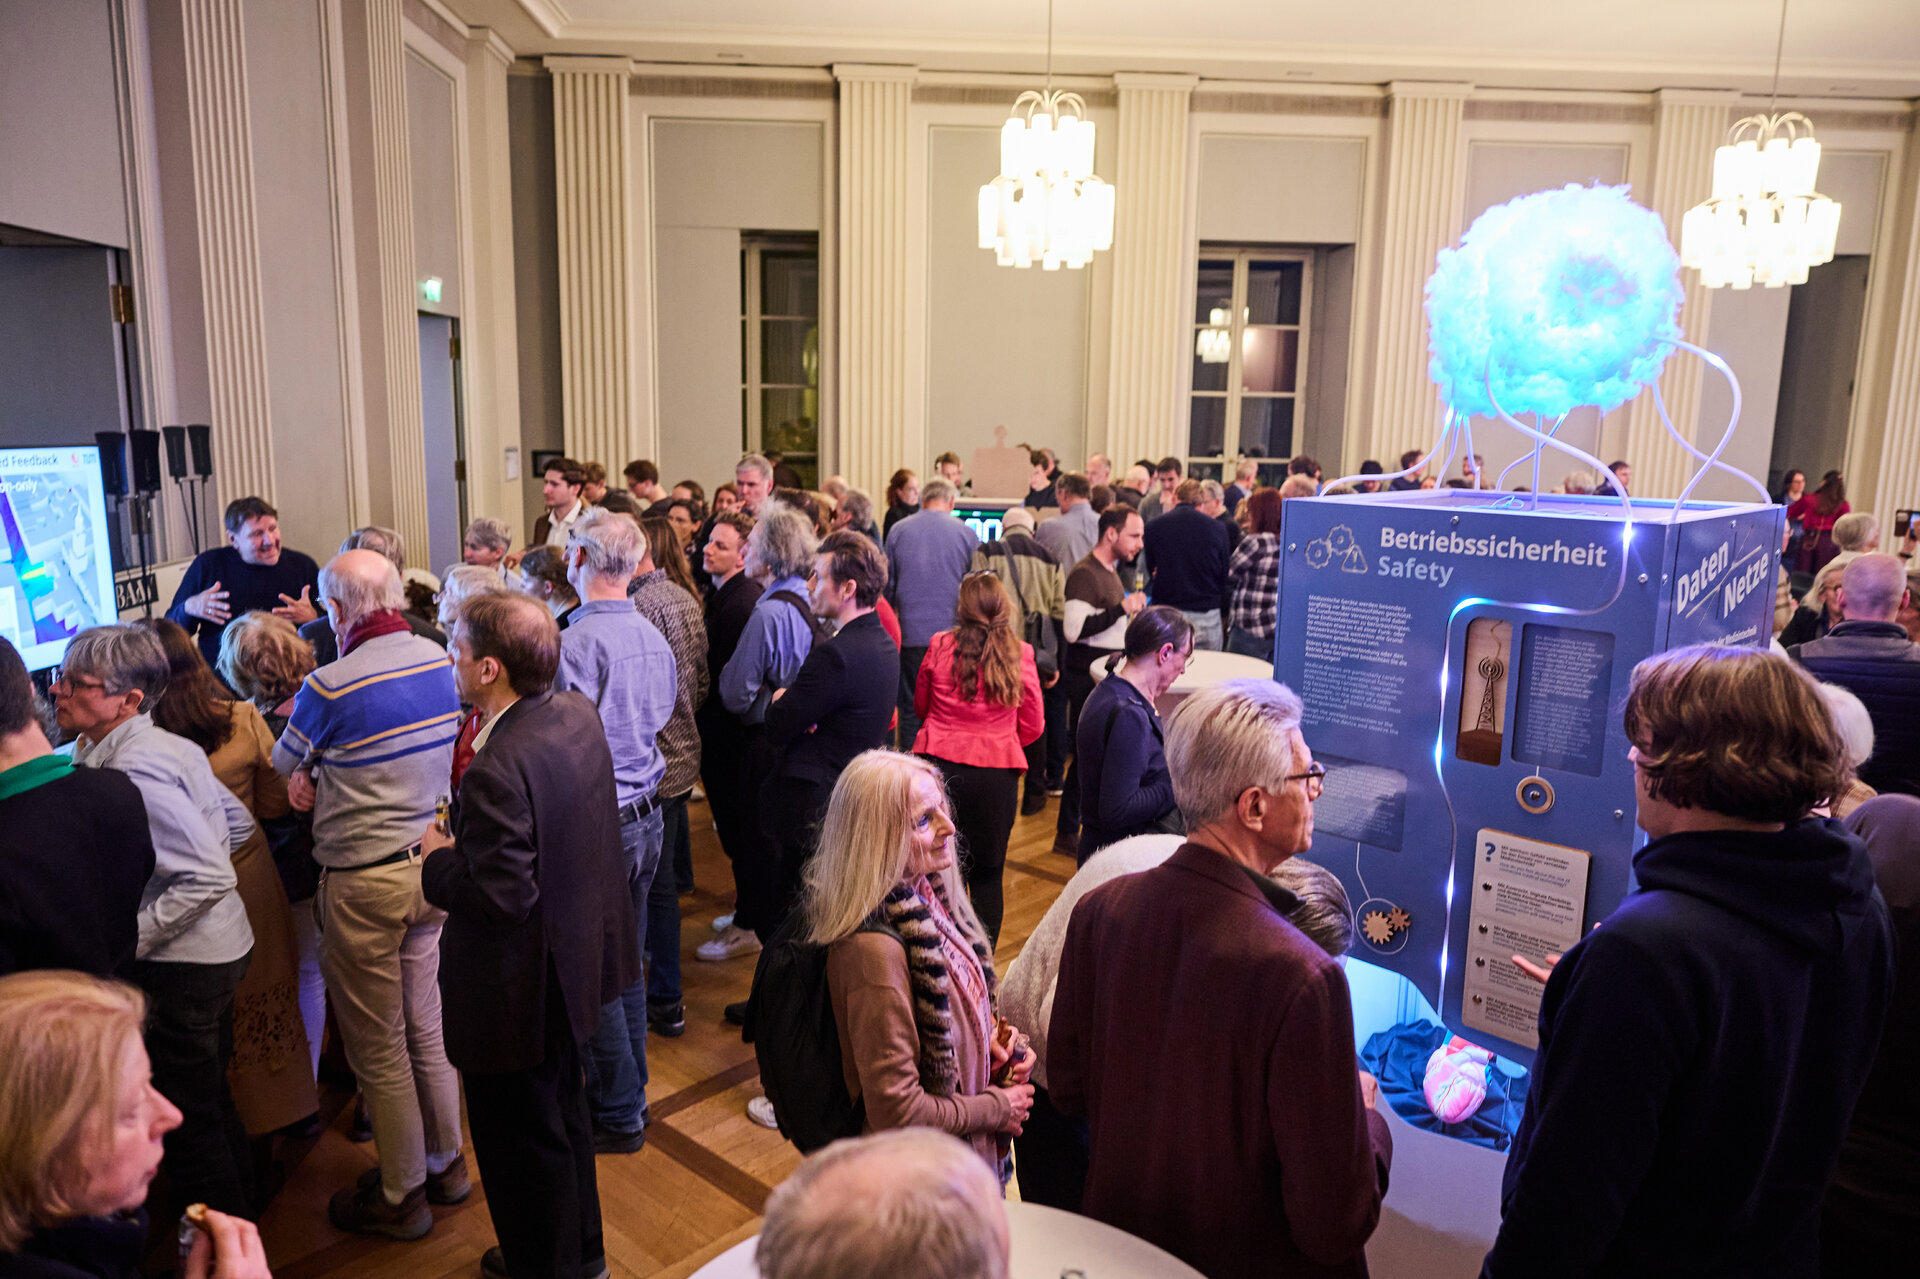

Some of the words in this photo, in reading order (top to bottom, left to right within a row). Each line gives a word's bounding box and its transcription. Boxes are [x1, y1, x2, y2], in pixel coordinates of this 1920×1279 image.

[12, 453, 58, 467] Feedback
[1380, 527, 1608, 567] Betriebssicherheit
[1377, 555, 1454, 588] Safety
[1677, 541, 1729, 615] Daten
[1723, 552, 1769, 619] Netze
